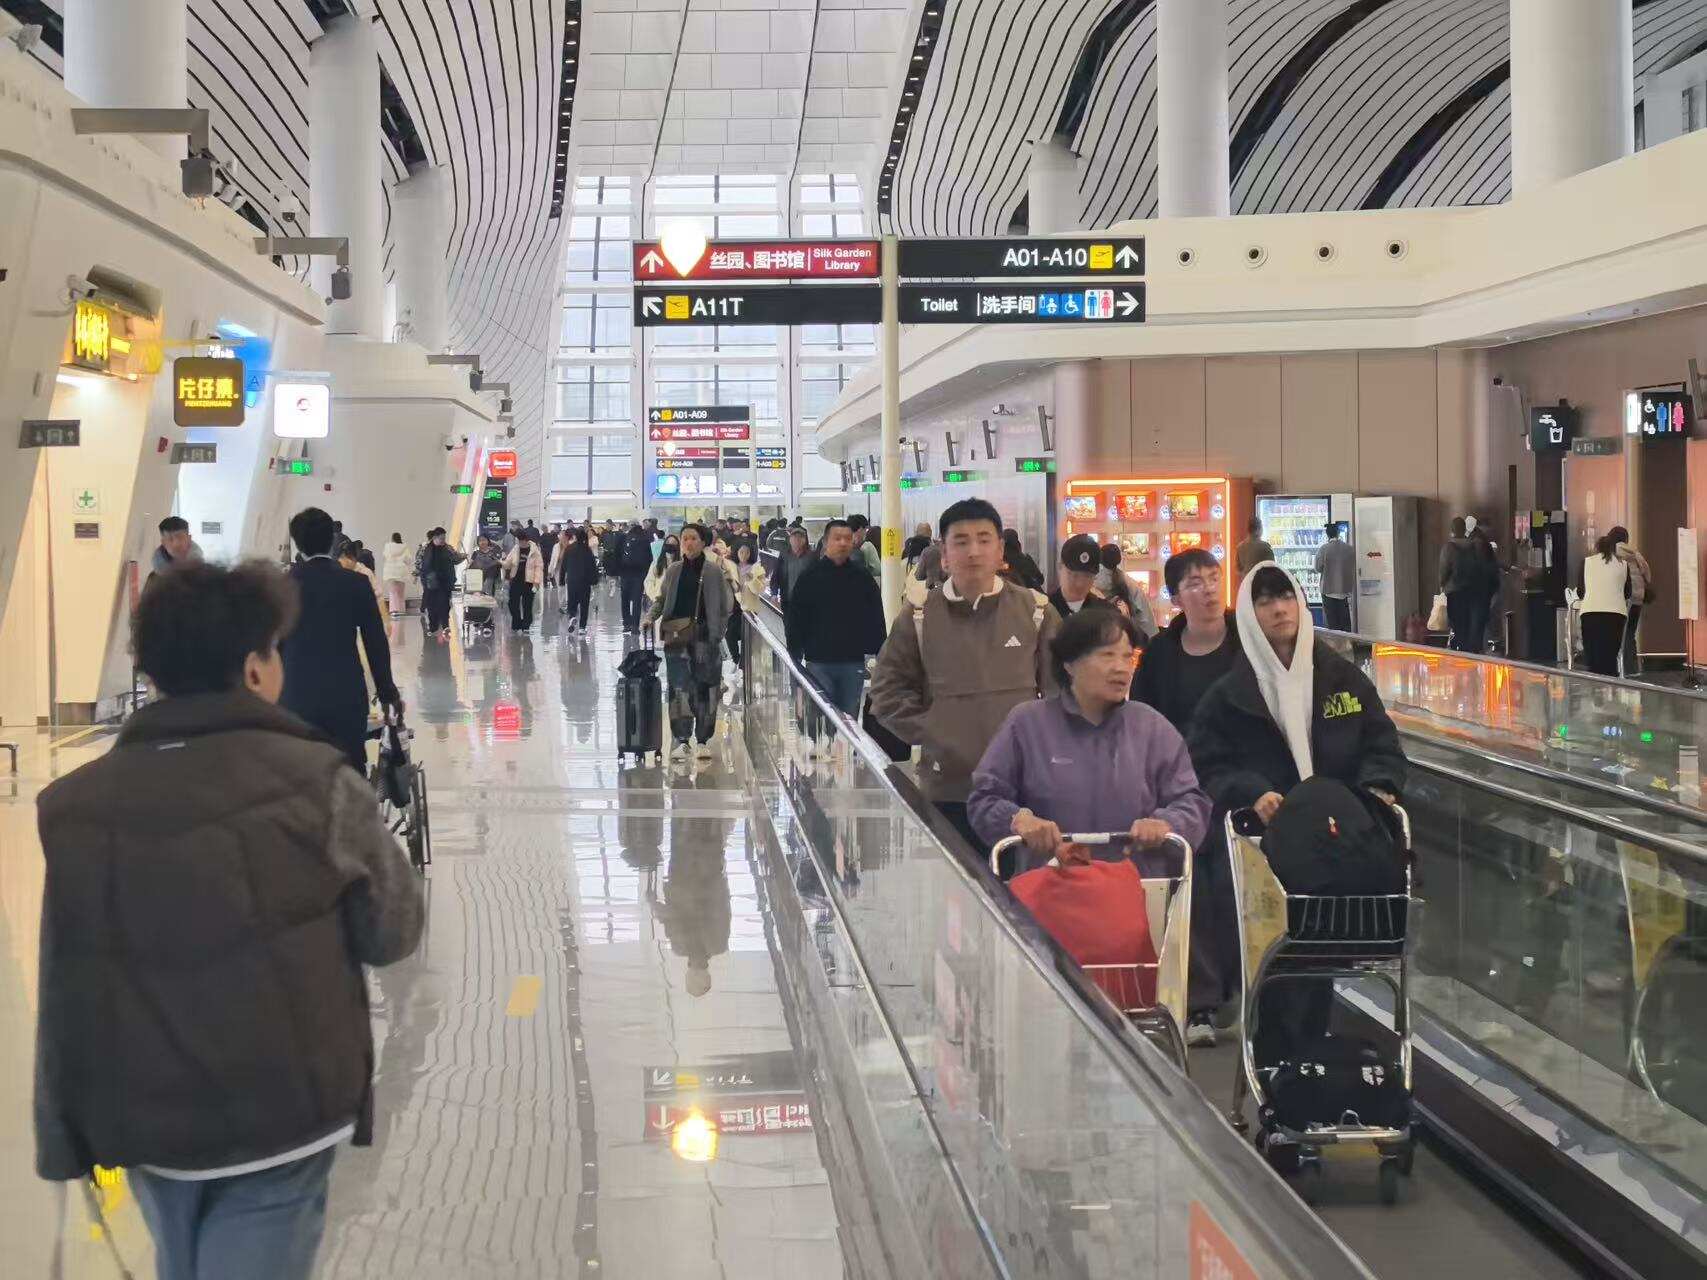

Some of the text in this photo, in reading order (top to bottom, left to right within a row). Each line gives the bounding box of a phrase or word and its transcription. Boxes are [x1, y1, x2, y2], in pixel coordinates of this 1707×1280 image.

[709, 250, 804, 270] 丝园、图书馆
[813, 247, 872, 259] Silk Garden
[1003, 248, 1087, 267] A01-A10
[824, 259, 861, 272] Library
[692, 297, 744, 316] A11T
[920, 298, 959, 312] Toilet
[982, 296, 1036, 314] 洗手间
